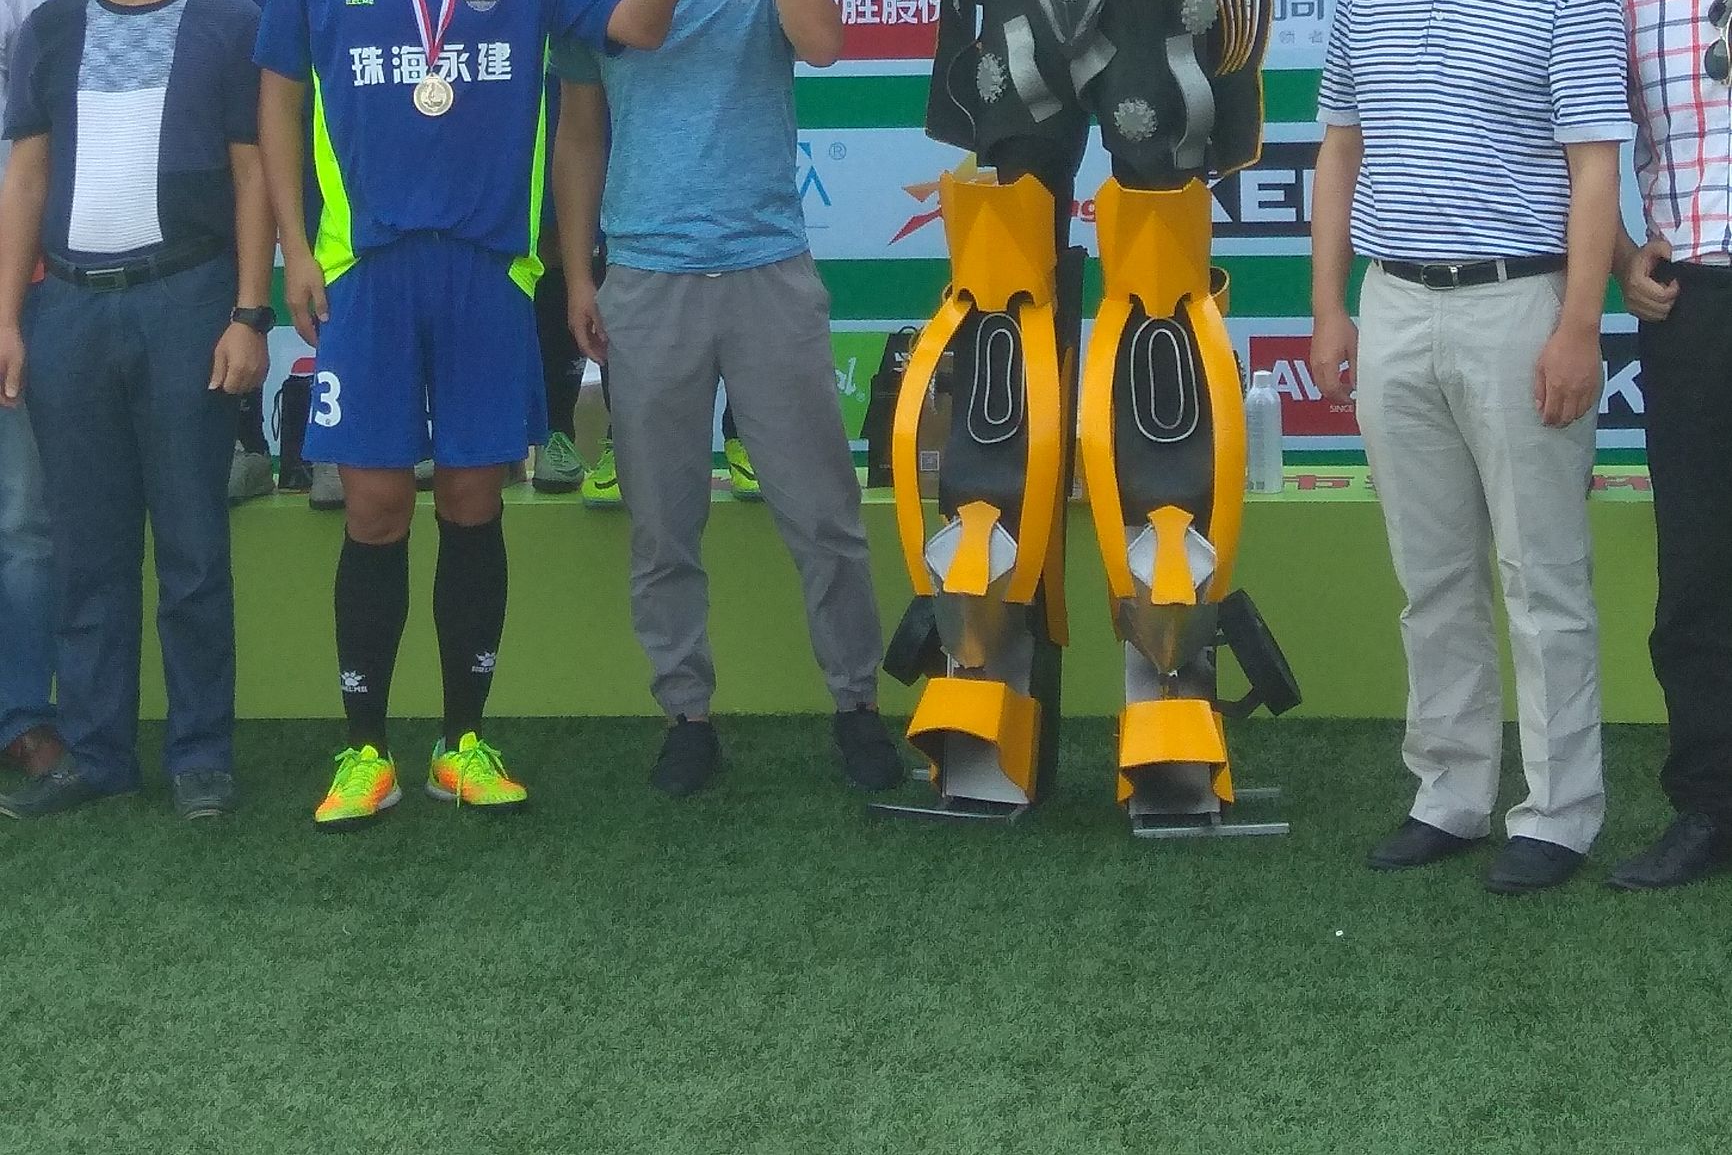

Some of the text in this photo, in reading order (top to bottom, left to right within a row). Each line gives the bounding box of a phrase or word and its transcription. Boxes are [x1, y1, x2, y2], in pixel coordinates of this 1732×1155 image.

[350, 42, 512, 86] 珠海永建
[309, 370, 342, 427] 3
